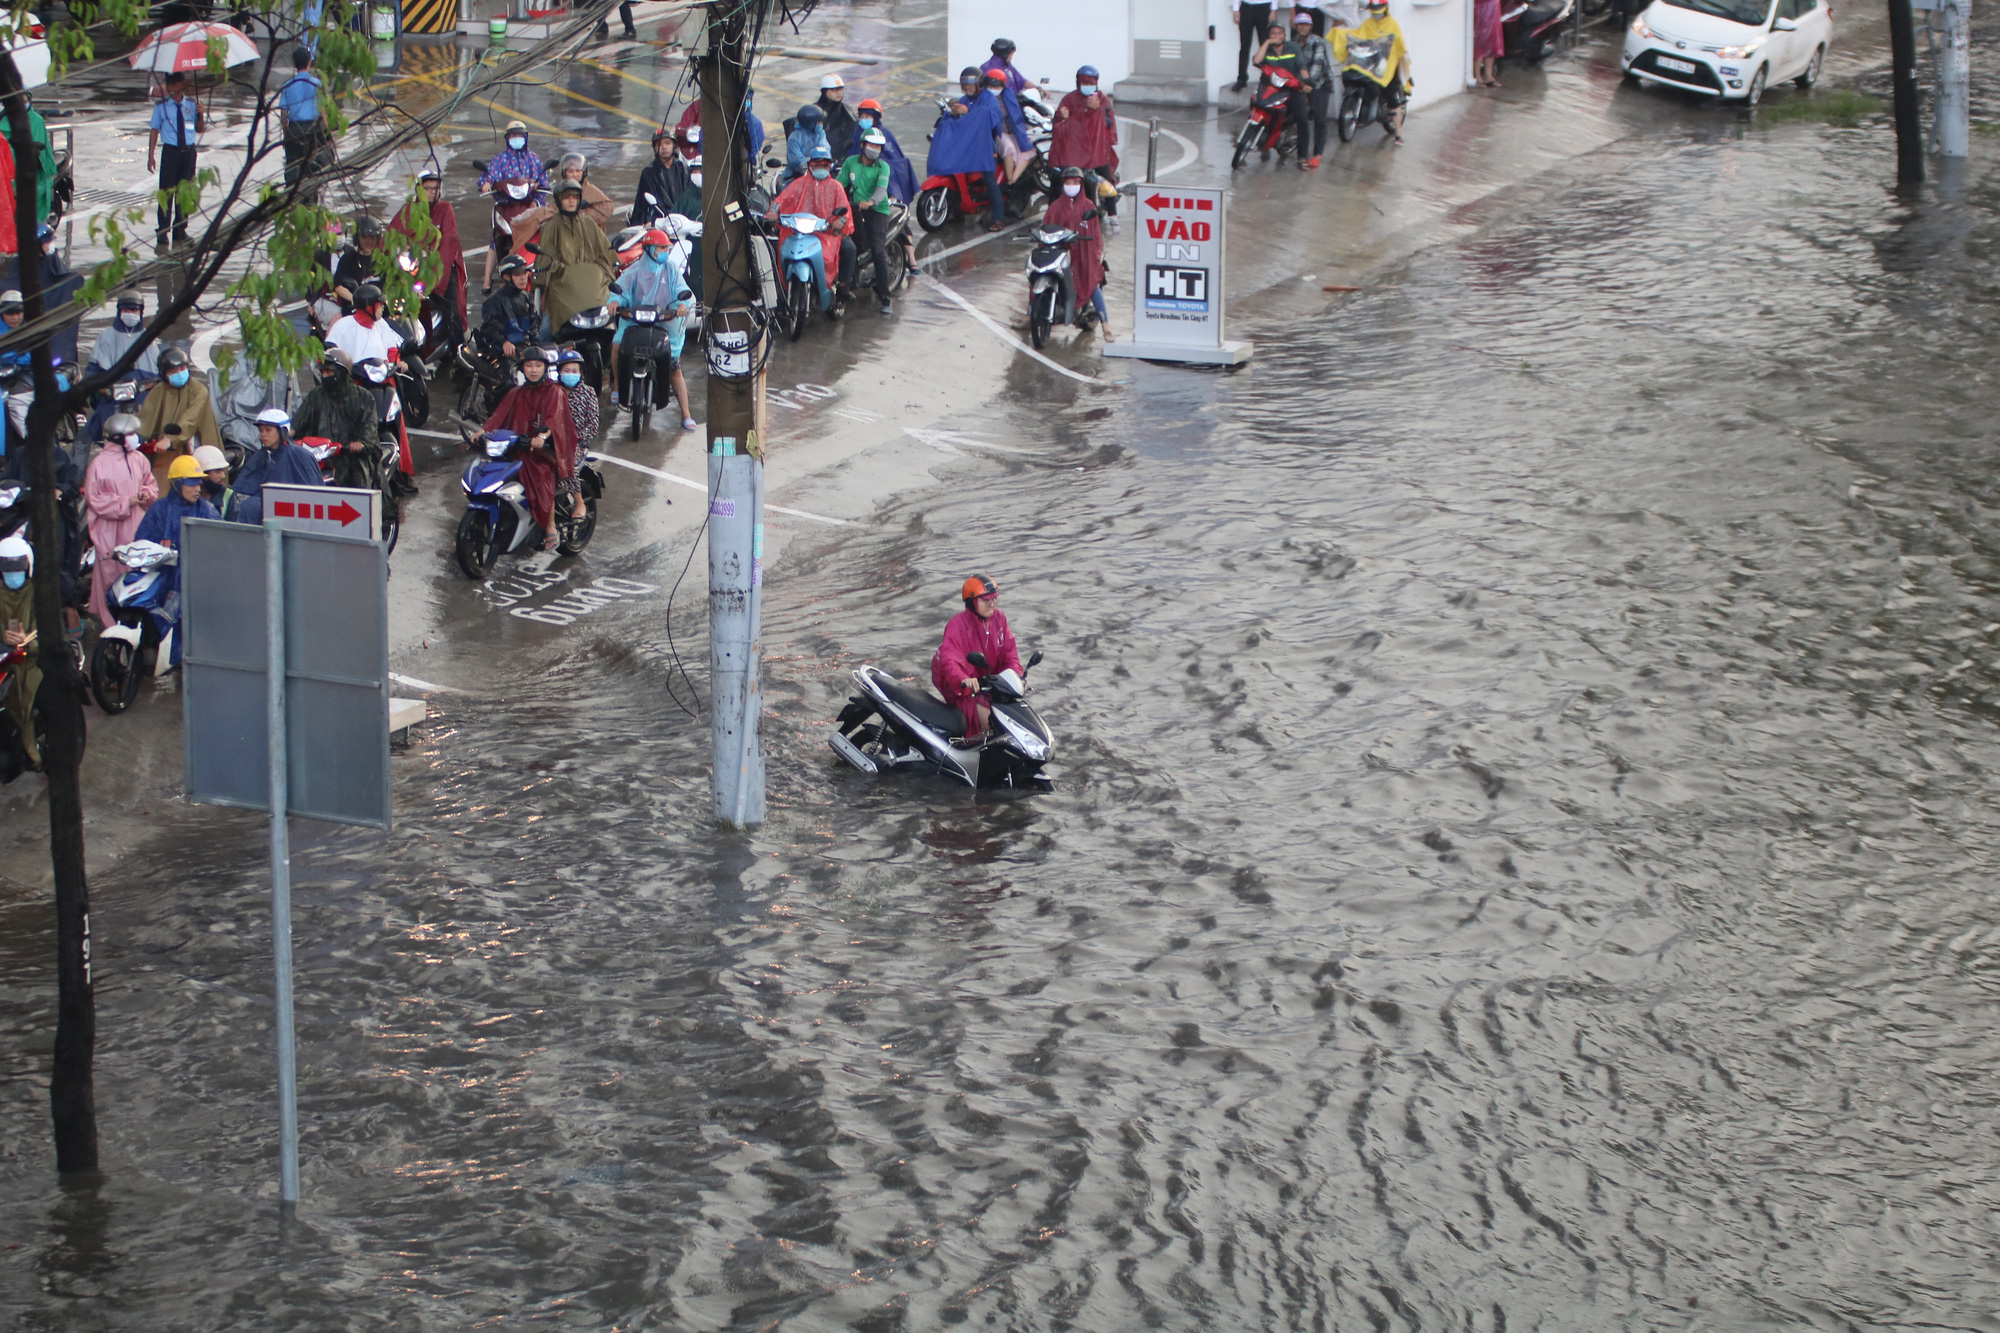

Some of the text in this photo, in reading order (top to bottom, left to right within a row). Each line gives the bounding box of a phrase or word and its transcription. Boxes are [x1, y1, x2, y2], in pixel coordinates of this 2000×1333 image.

[1146, 216, 1211, 242] VÀO
[1156, 243, 1200, 262] IN
[1149, 269, 1205, 300] HT
[1148, 301, 1206, 311] Hiroshima TOYOTA
[1146, 311, 1160, 320] Toyota
[715, 354, 731, 366] 62
